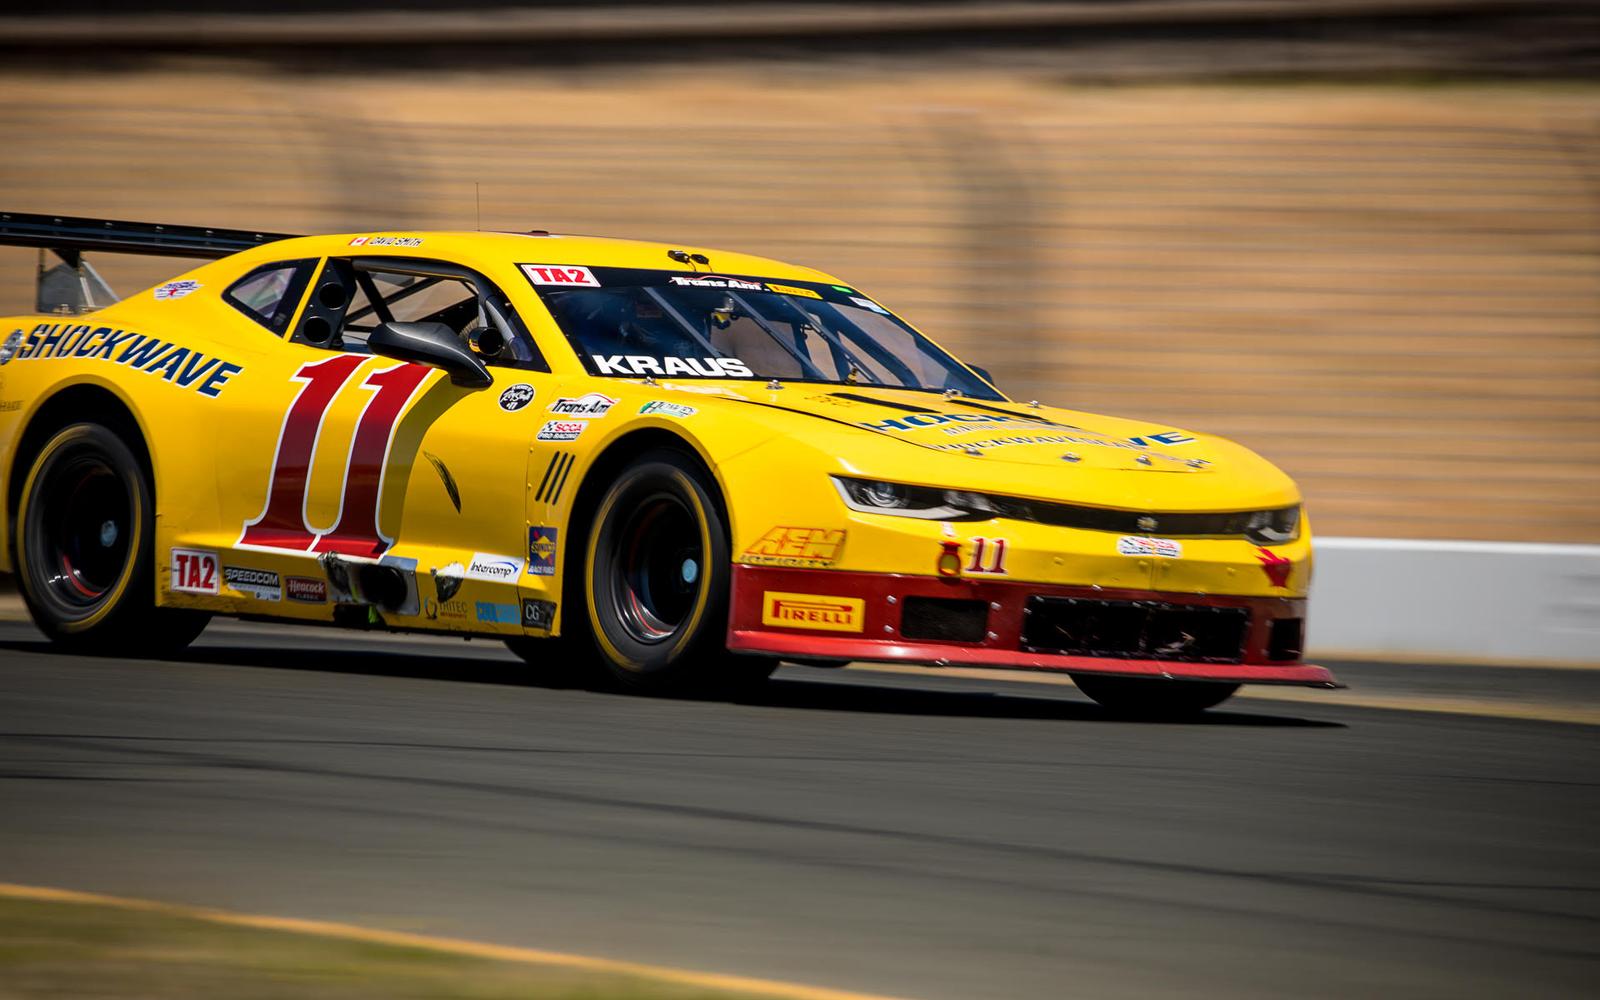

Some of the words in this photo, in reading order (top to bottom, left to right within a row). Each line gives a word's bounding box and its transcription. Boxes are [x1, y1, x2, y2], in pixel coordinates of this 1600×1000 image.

[531, 267, 590, 284] TA2
[671, 277, 727, 288] Trans
[728, 281, 763, 290] Am
[18, 324, 244, 397] SHOCKWAVE
[592, 354, 753, 377] KRAUS
[552, 398, 588, 413] Trans
[586, 399, 611, 413] Am
[555, 423, 582, 432] SCCA
[233, 353, 436, 563] 11
[745, 526, 847, 561] AEM
[964, 536, 1008, 577] 11
[176, 554, 216, 589] TA2
[224, 568, 279, 586] SPEEDCOM
[470, 562, 512, 579] Intercomp
[772, 599, 854, 624] PIRELLI
